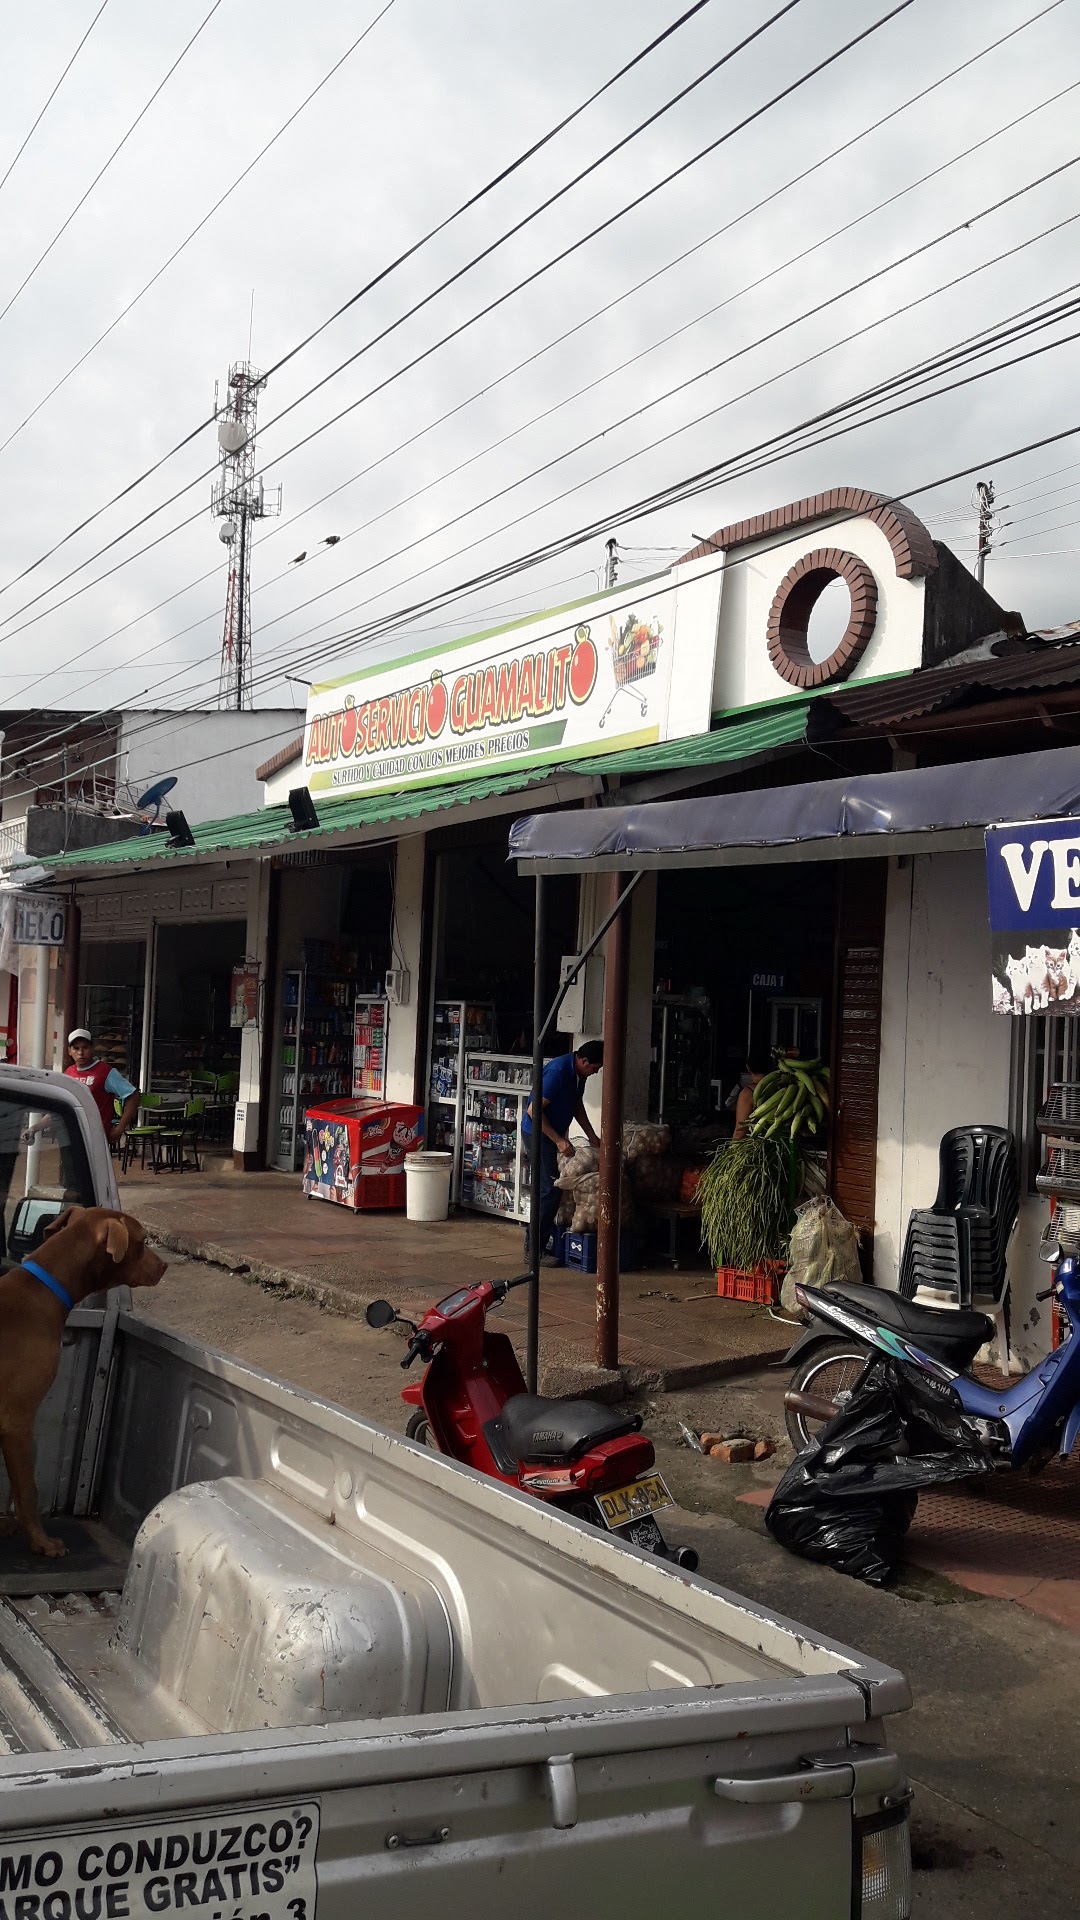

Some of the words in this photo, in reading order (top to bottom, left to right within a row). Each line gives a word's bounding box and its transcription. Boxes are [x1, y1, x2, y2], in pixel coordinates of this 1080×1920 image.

[306, 669, 448, 766] AUTOSERVICIO
[450, 624, 598, 735] GUAMALITO
[333, 766, 364, 785] SURTIDO
[366, 764, 372, 779] Y
[372, 757, 405, 777] CALIDAD
[407, 754, 425, 772] CON
[427, 750, 442, 768] LOS
[445, 741, 484, 765] MEJORES
[488, 731, 529, 755] PRECIOS
[753, 973, 777, 986] CAJA
[778, 975, 784, 987] 1
[77, 1816, 313, 1882] CONDUZCO?
